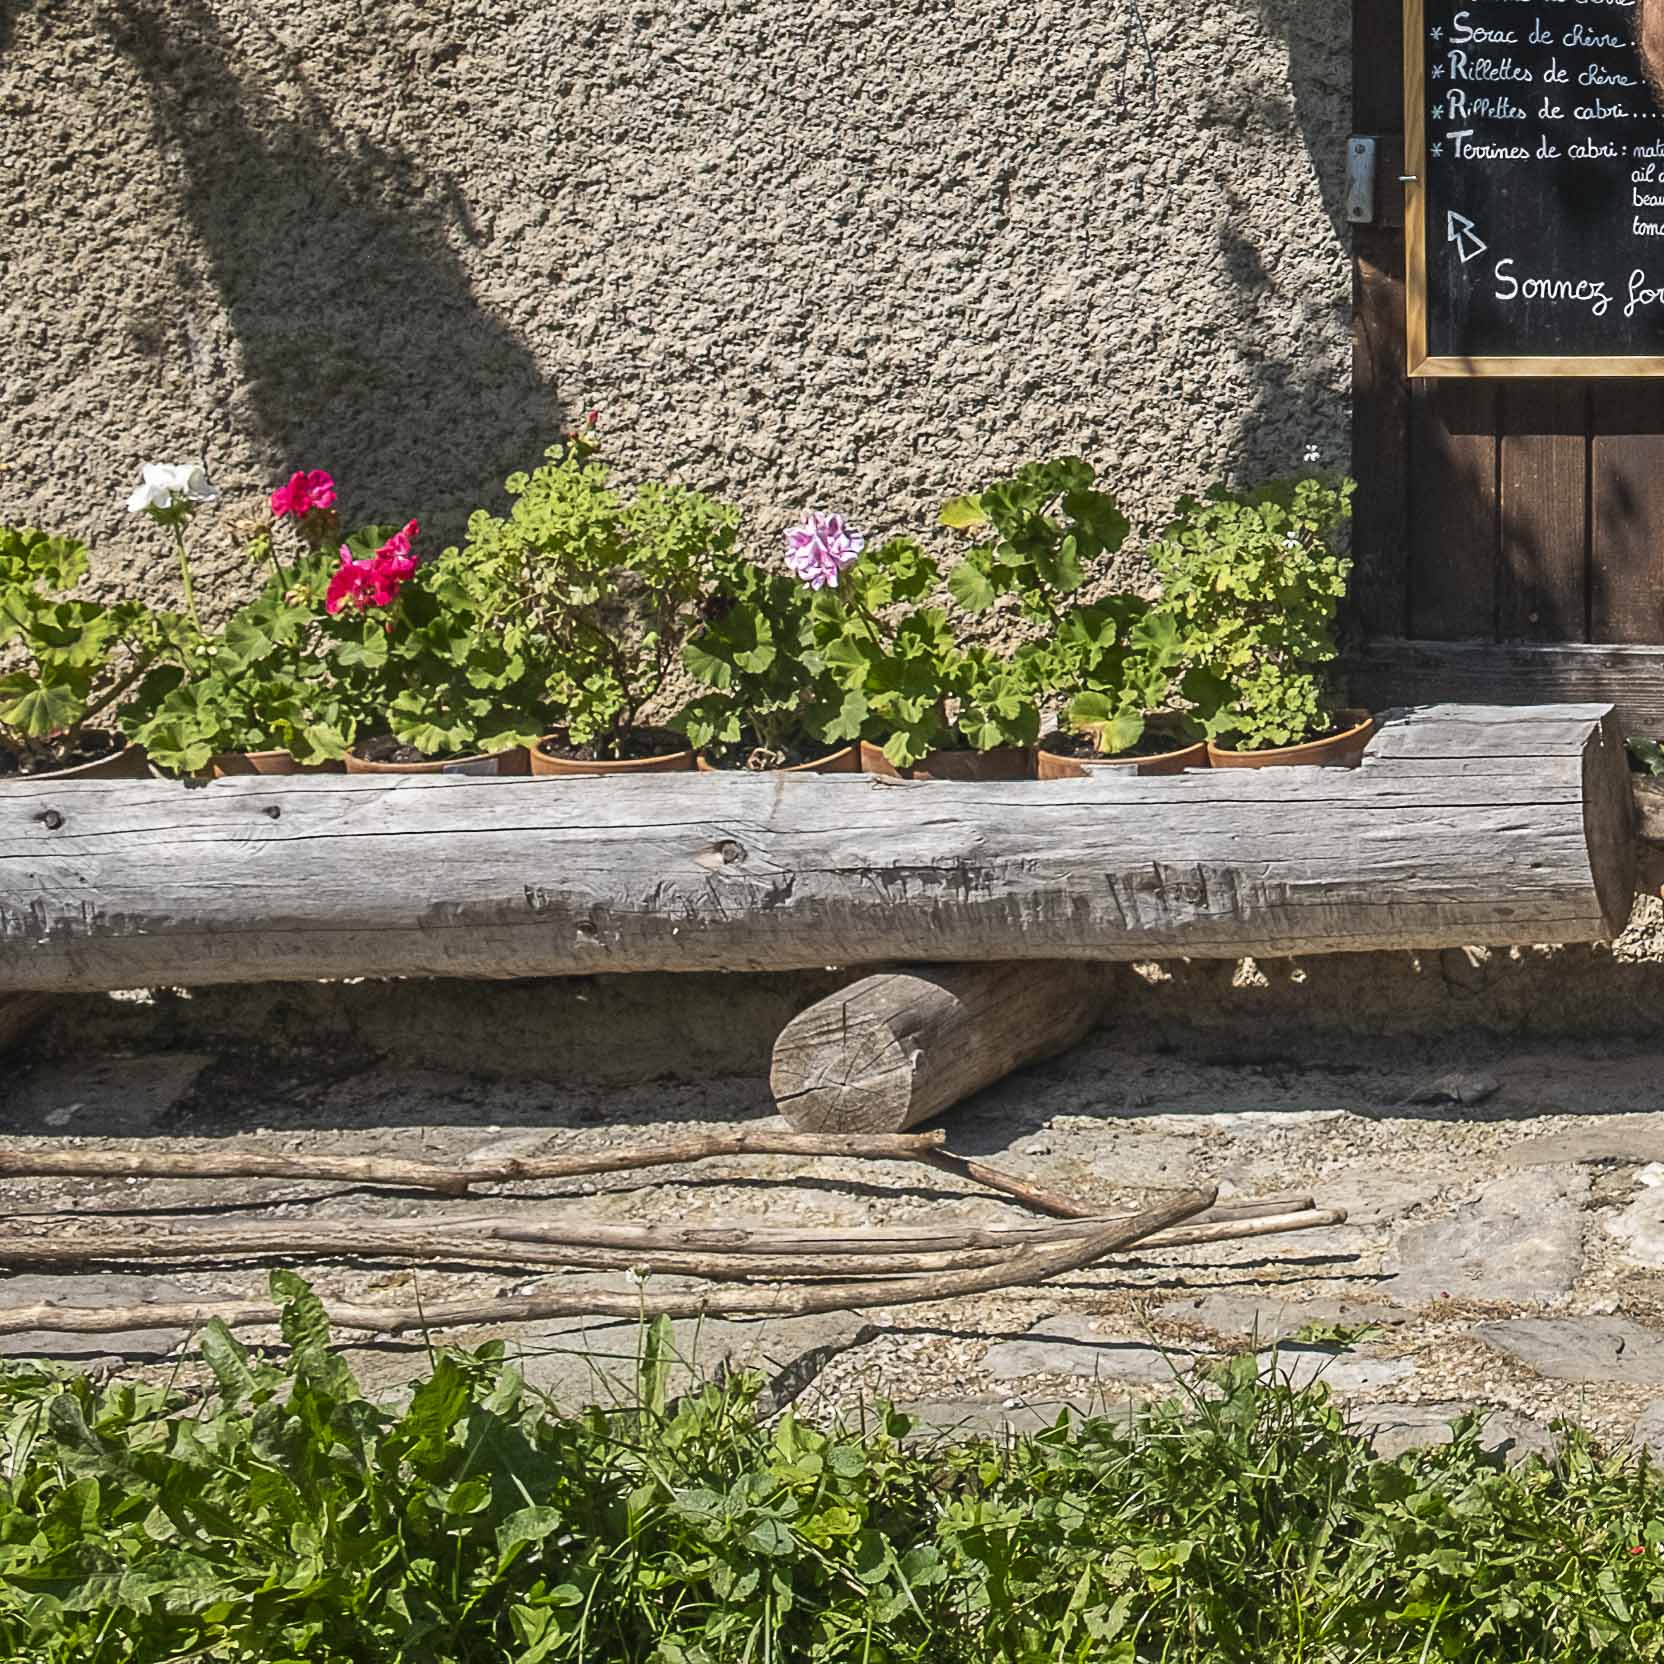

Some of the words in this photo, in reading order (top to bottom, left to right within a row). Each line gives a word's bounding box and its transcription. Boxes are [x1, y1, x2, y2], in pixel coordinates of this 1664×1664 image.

[1529, 17, 1554, 44] de
[1447, 49, 1533, 82] Rillettes
[1543, 57, 1569, 83] de
[1446, 88, 1527, 120] Rillettes
[1538, 96, 1565, 120] de
[1446, 129, 1530, 160] Terrines
[1536, 134, 1561, 159] de
[1631, 162, 1656, 183] ail
[1495, 258, 1613, 316] Sonnez
